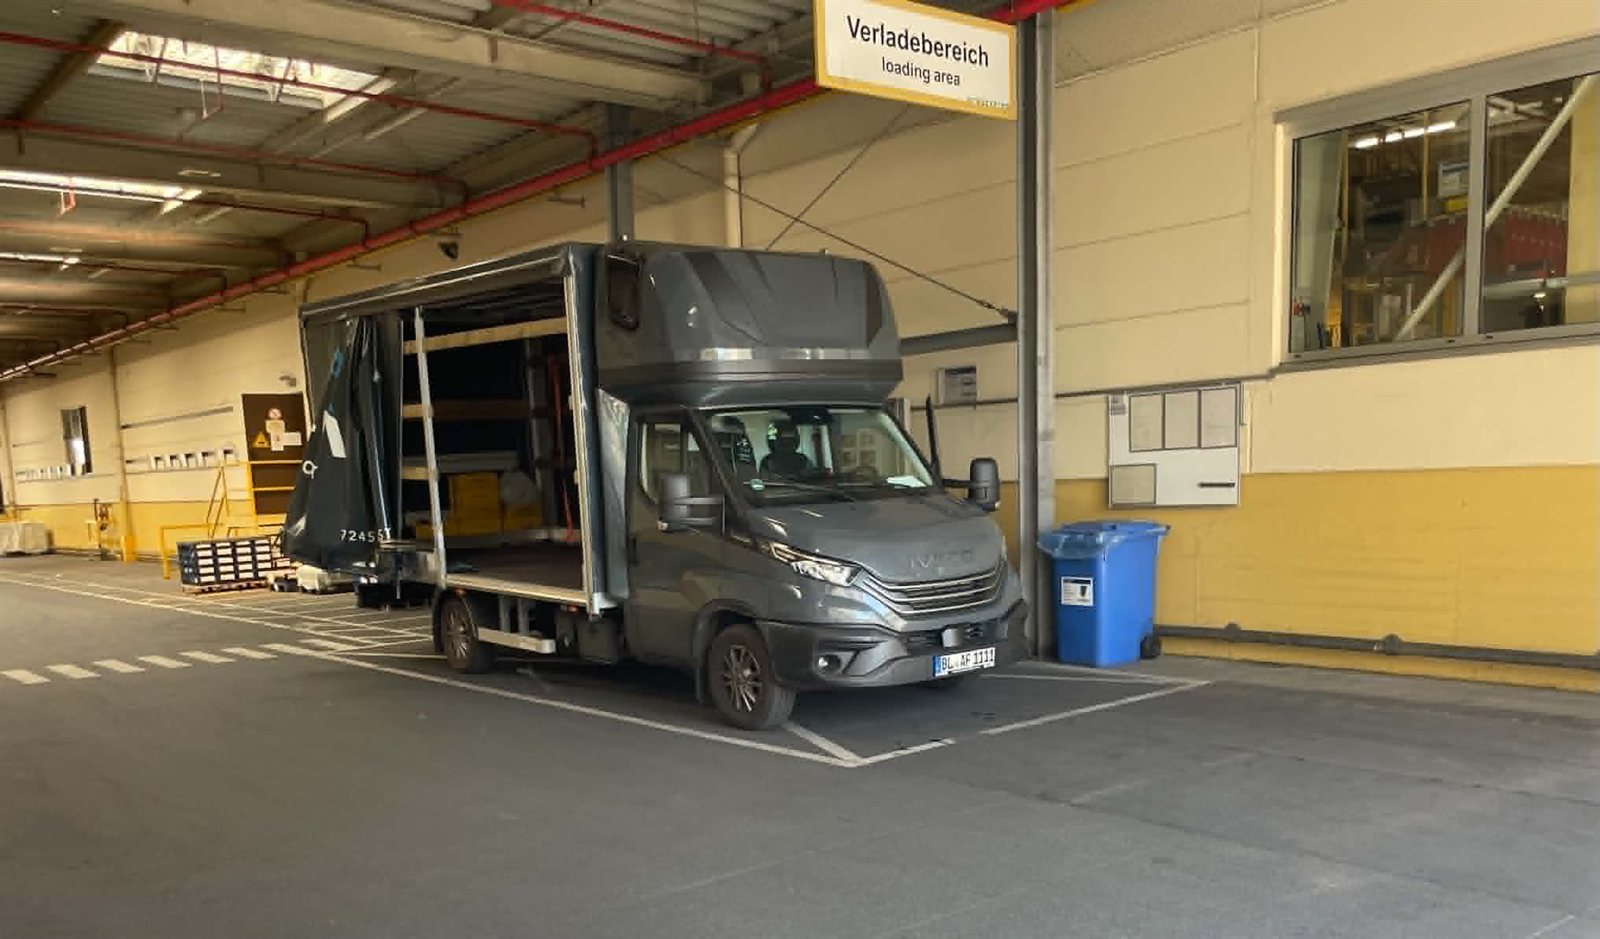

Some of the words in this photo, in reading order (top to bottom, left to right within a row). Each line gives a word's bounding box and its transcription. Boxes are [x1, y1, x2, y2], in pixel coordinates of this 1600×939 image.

[846, 15, 988, 67] Verladebereich
[882, 57, 930, 84] loading
[934, 69, 961, 87] area
